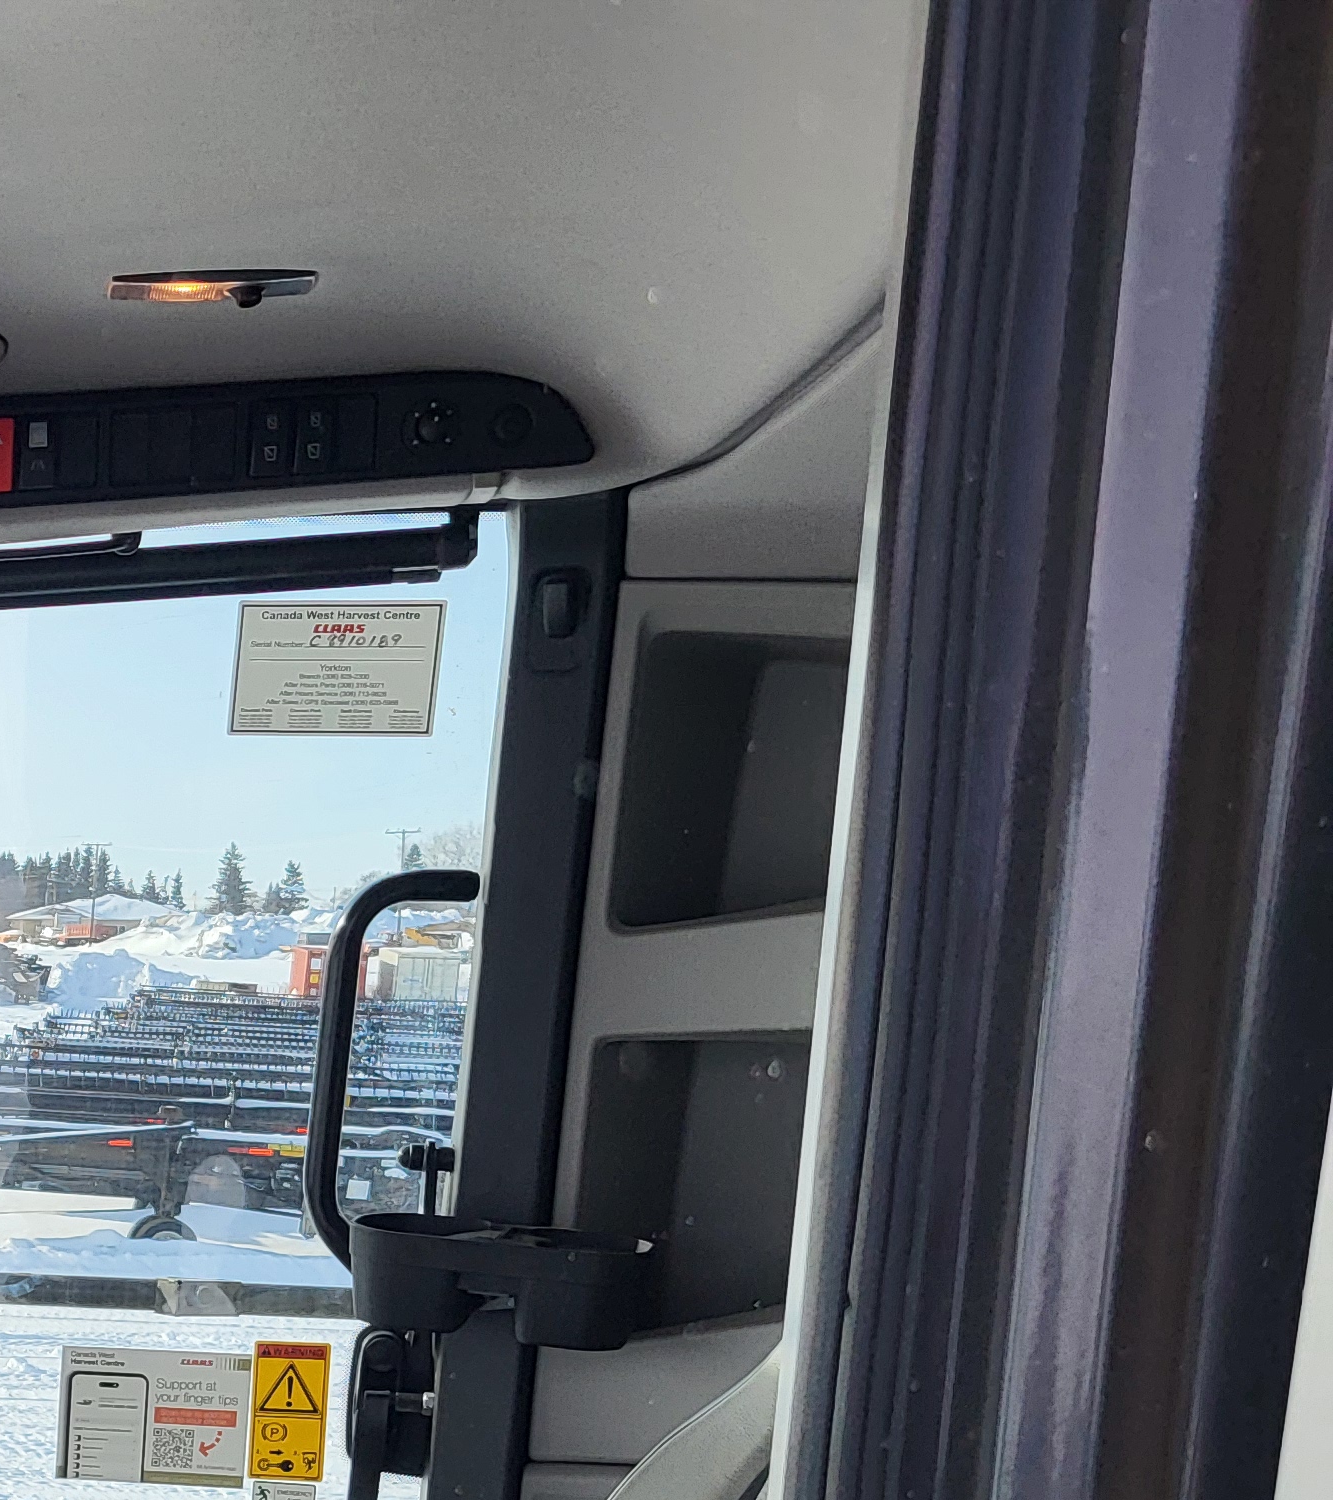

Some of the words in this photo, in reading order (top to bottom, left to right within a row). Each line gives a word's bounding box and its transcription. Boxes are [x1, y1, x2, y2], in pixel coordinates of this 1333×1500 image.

[261, 611, 303, 620] Canada
[306, 611, 334, 620] West
[337, 611, 380, 620] Harvest
[383, 611, 420, 620] Centre
[313, 624, 366, 634] CLAAS
[319, 664, 351, 672] Yorkton
[273, 1347, 324, 1357] WARNING
[70, 1358, 98, 1366] Harvest
[100, 1359, 125, 1367] Centre
[155, 1378, 202, 1392] Support
[205, 1381, 217, 1391] at
[154, 1393, 180, 1405] your
[183, 1392, 214, 1407] finger
[218, 1394, 239, 1407] tips
